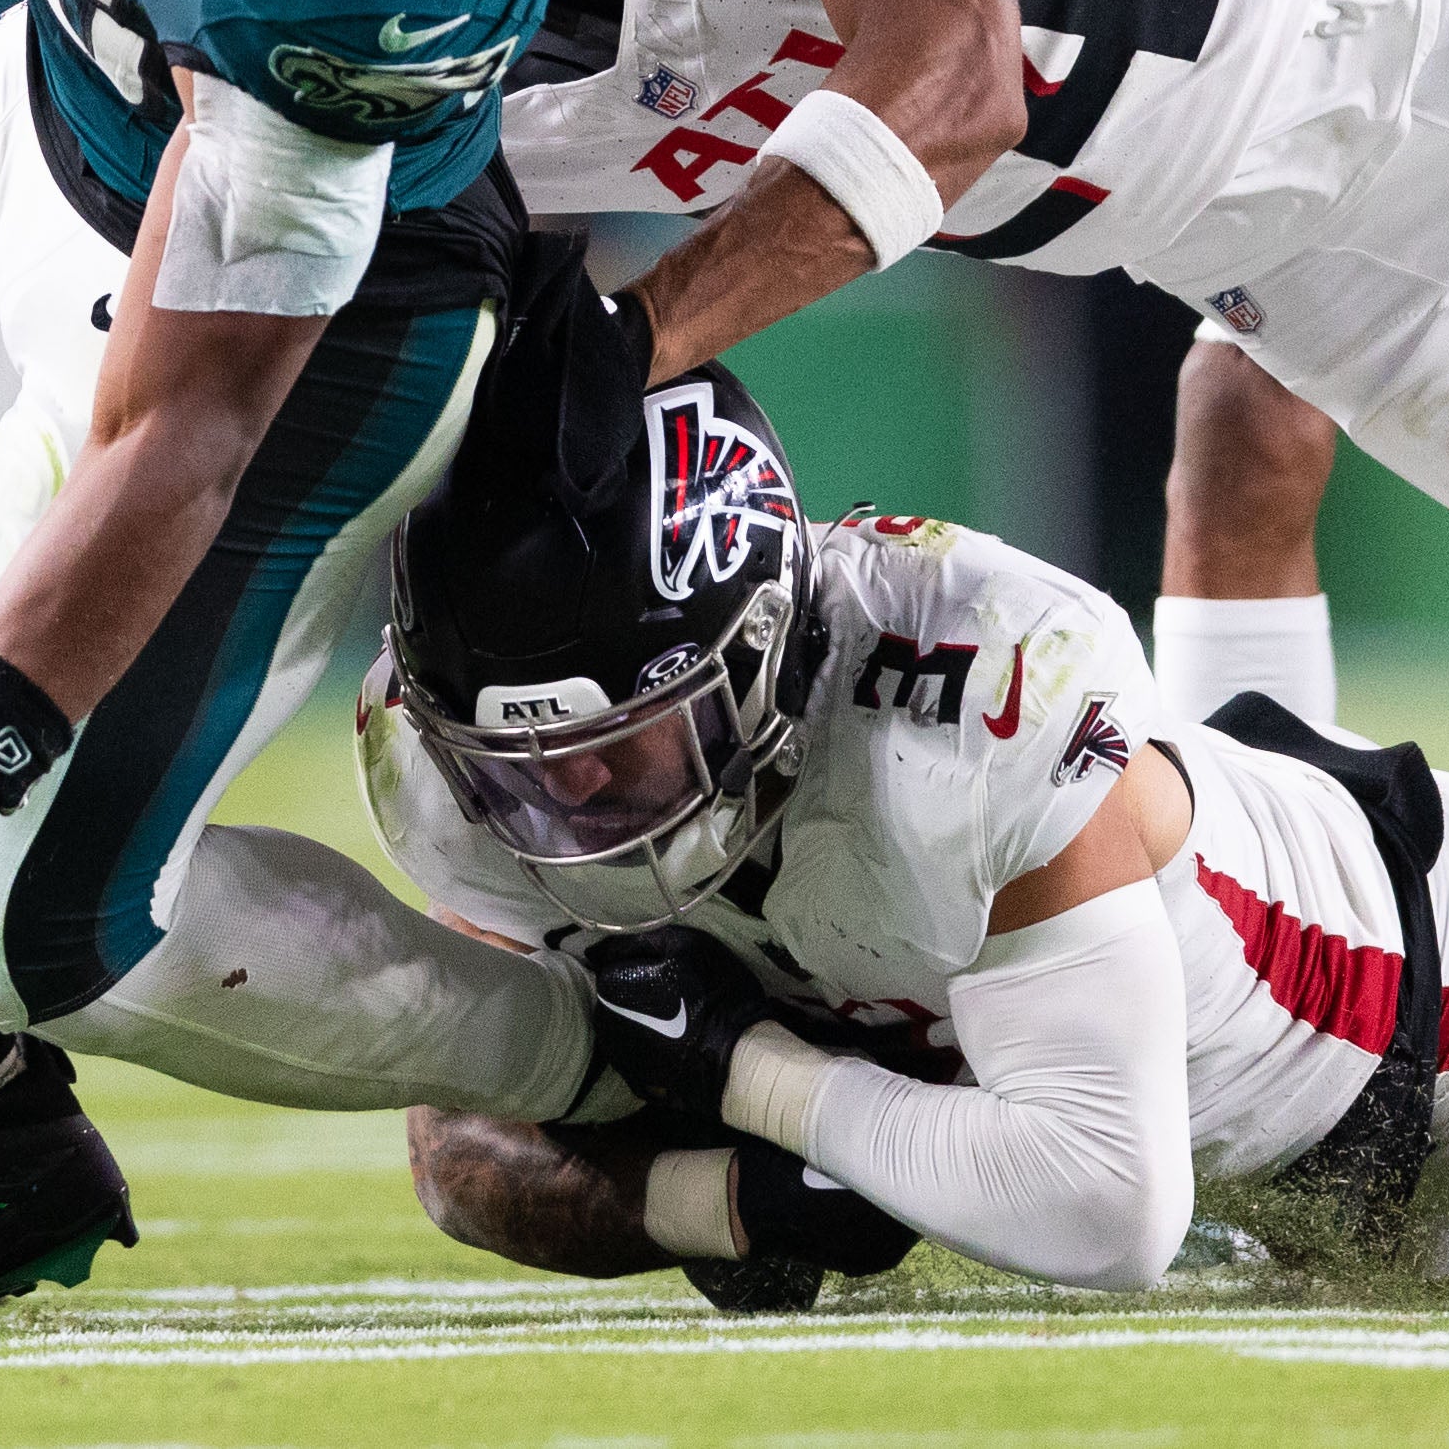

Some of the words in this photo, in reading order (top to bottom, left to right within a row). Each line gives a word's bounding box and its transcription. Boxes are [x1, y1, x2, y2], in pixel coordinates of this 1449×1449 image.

[656, 84, 692, 116] NFL
[1225, 304, 1260, 330] NFL
[502, 697, 571, 721] ATL
